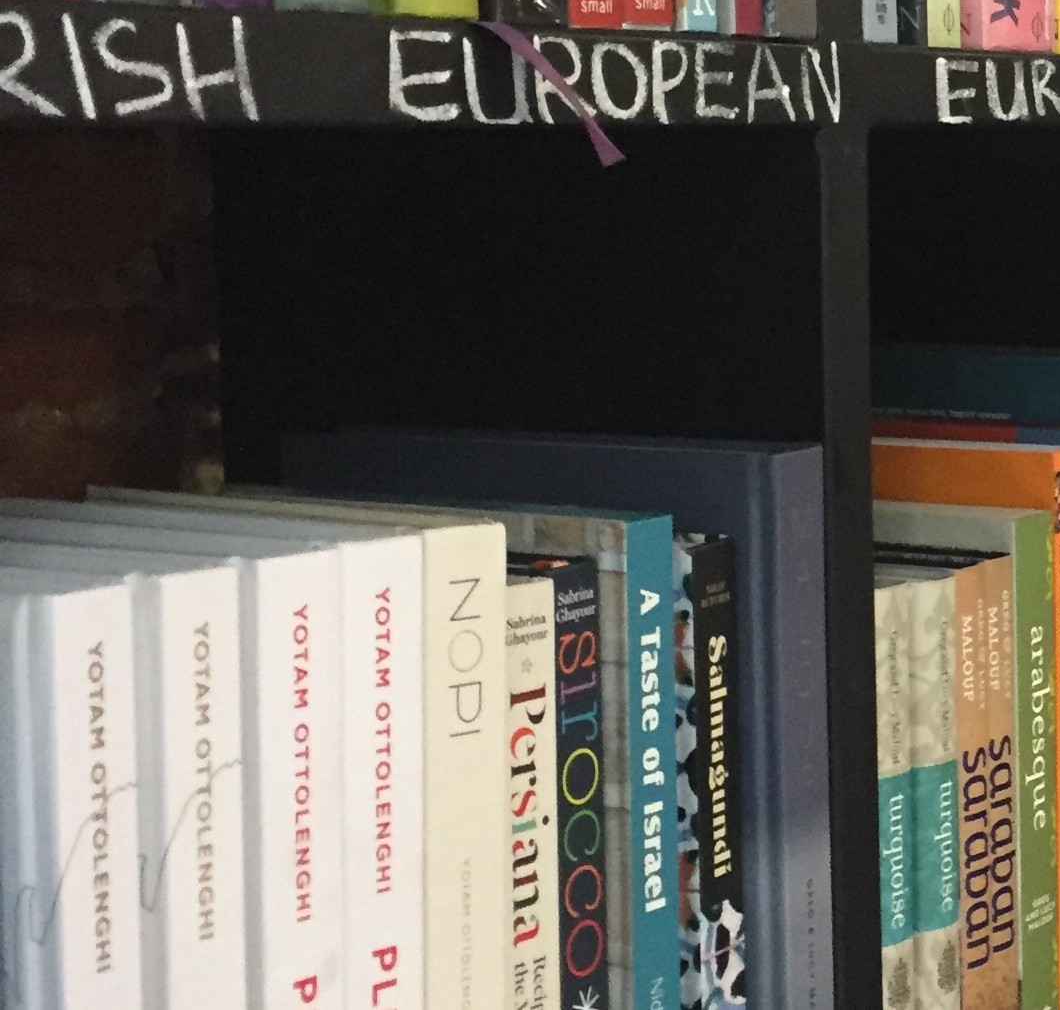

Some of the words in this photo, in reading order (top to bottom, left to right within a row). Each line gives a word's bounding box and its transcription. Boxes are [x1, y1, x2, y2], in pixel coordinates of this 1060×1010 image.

[0, 10, 259, 121] RISH
[389, 28, 842, 125] EUROPEAN
[374, 585, 391, 690] YOTAM
[506, 613, 547, 631] Sabrina
[556, 602, 597, 625] Ghayour
[557, 587, 595, 607] Sabrina
[639, 588, 661, 616] A
[987, 606, 1001, 691] MALOUF
[87, 640, 104, 752] YOTAM
[193, 620, 213, 728] YOTAM
[292, 602, 311, 710] YOTAM
[448, 575, 484, 739] NOPI
[640, 625, 662, 733] Taste
[961, 614, 975, 702] MALOUF
[642, 746, 665, 787] of
[707, 634, 732, 879] Salmagundi
[1024, 625, 1051, 831] arabesque
[193, 740, 216, 942] OTTOLENGHI
[292, 722, 312, 924] OTTOLENGHI
[374, 700, 393, 896] OTTOLENGHI
[510, 682, 550, 948] Persiana
[933, 781, 955, 913] turquoise
[987, 734, 1017, 954] saraban
[89, 761, 113, 975] OTTOLENGHI
[643, 800, 667, 914] Israel
[882, 793, 910, 931] turquoise
[961, 747, 991, 970] saraban
